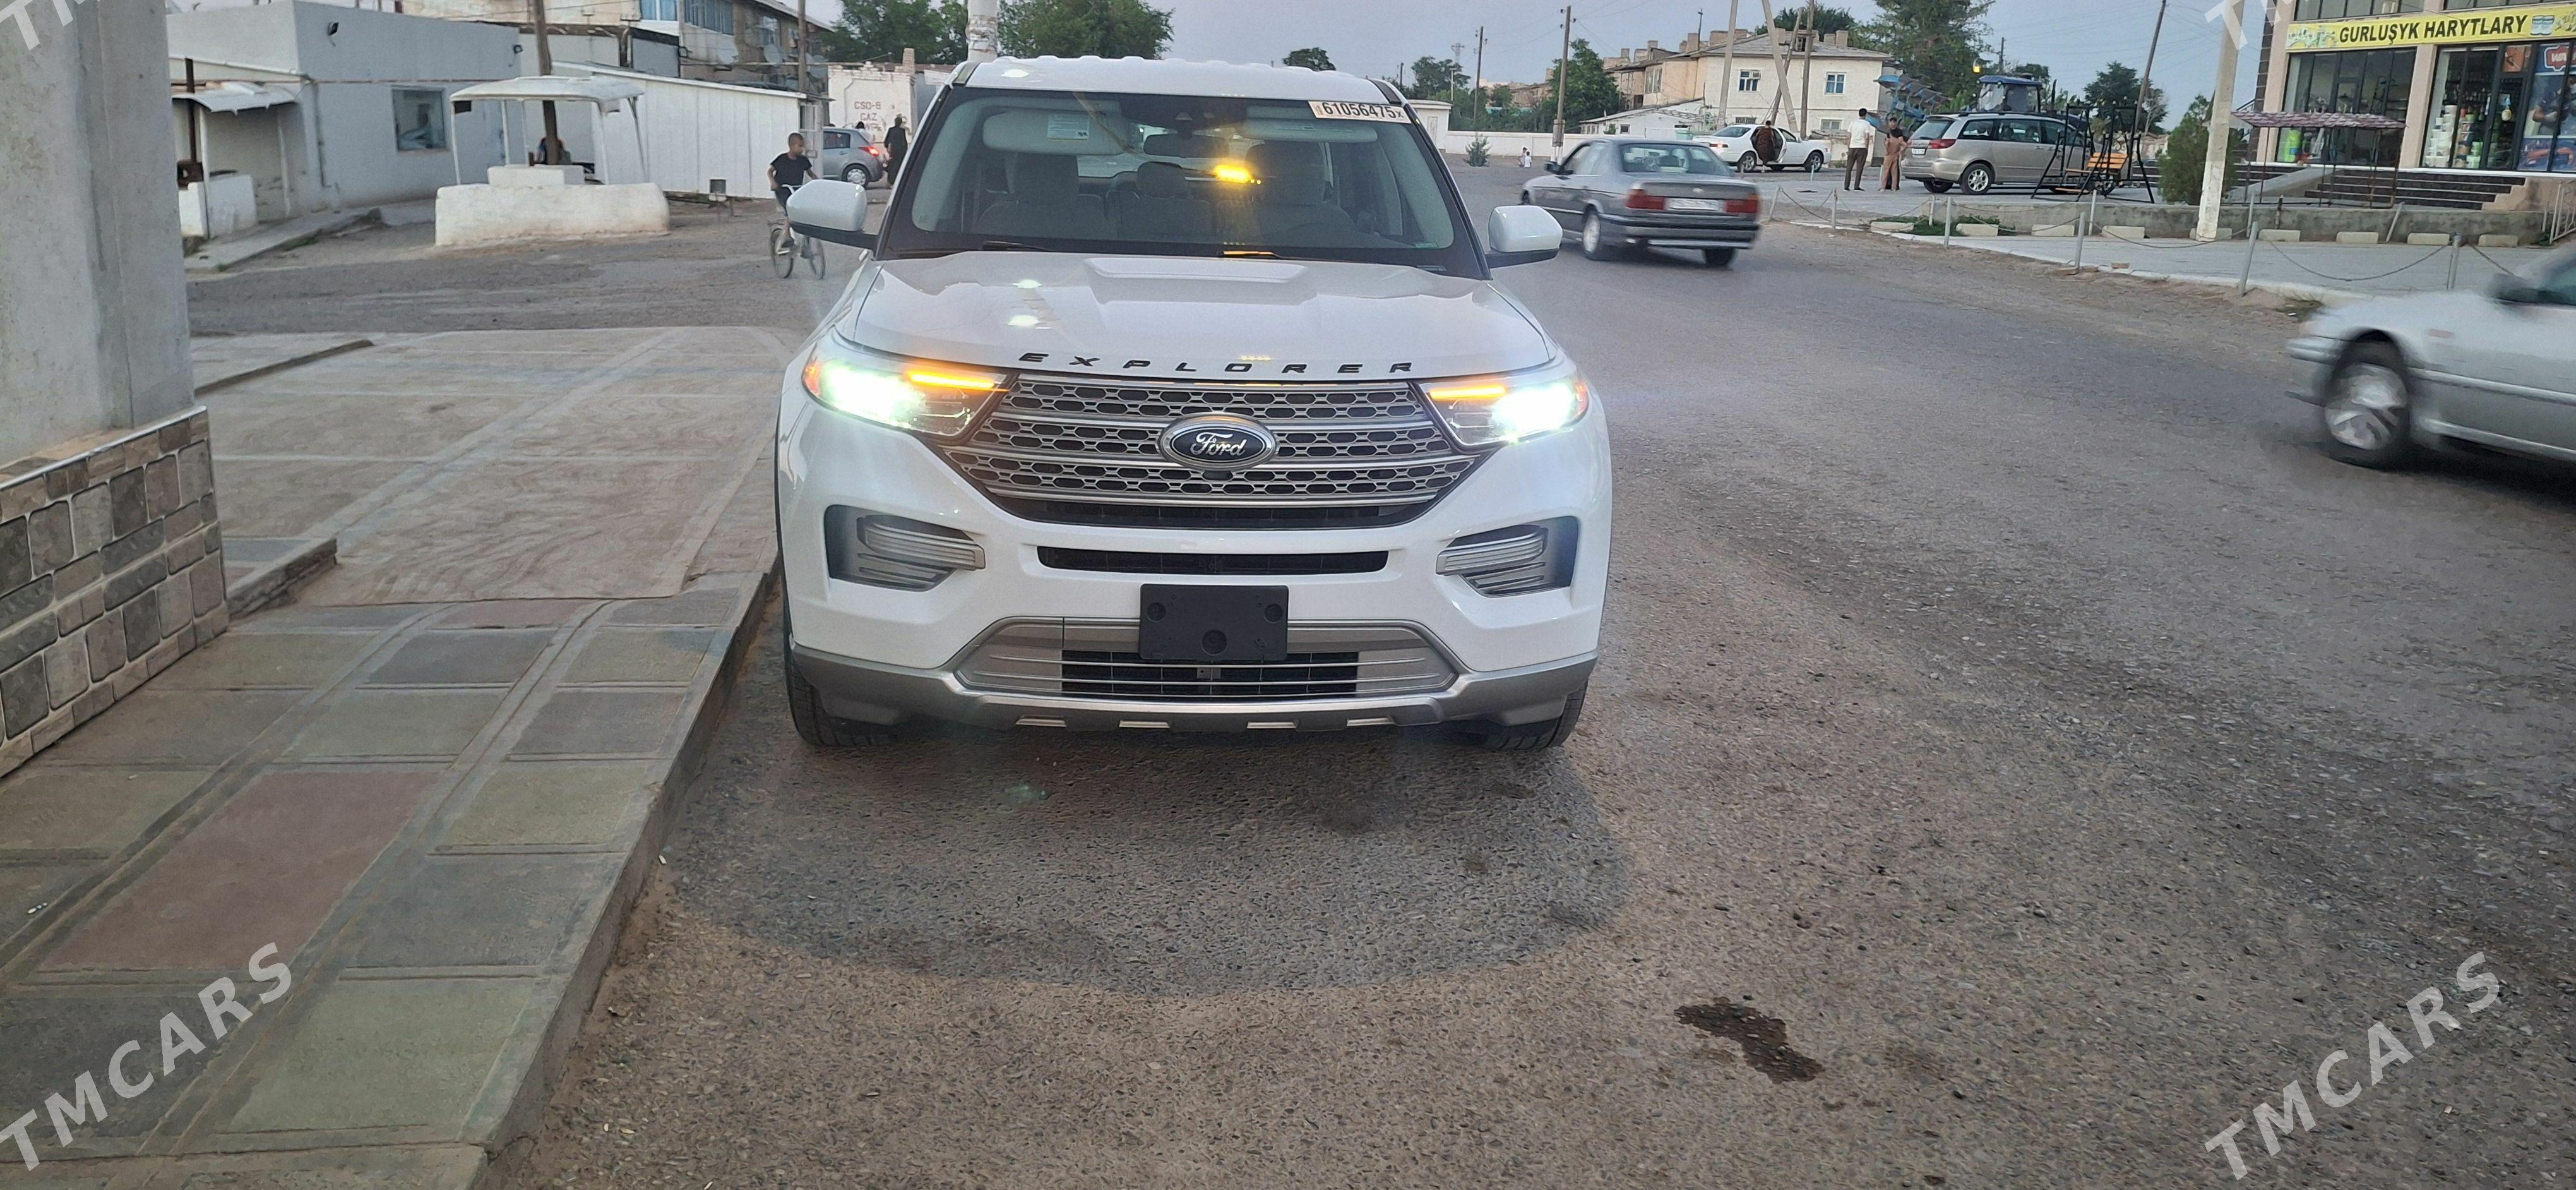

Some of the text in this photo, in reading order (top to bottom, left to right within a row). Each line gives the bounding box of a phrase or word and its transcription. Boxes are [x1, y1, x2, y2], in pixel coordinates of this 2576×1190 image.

[2339, 15, 2528, 45] GURLUŞYK HARYTLARY
[1018, 352, 1412, 374] EXPLORER
[1190, 431, 1247, 456] Ford
